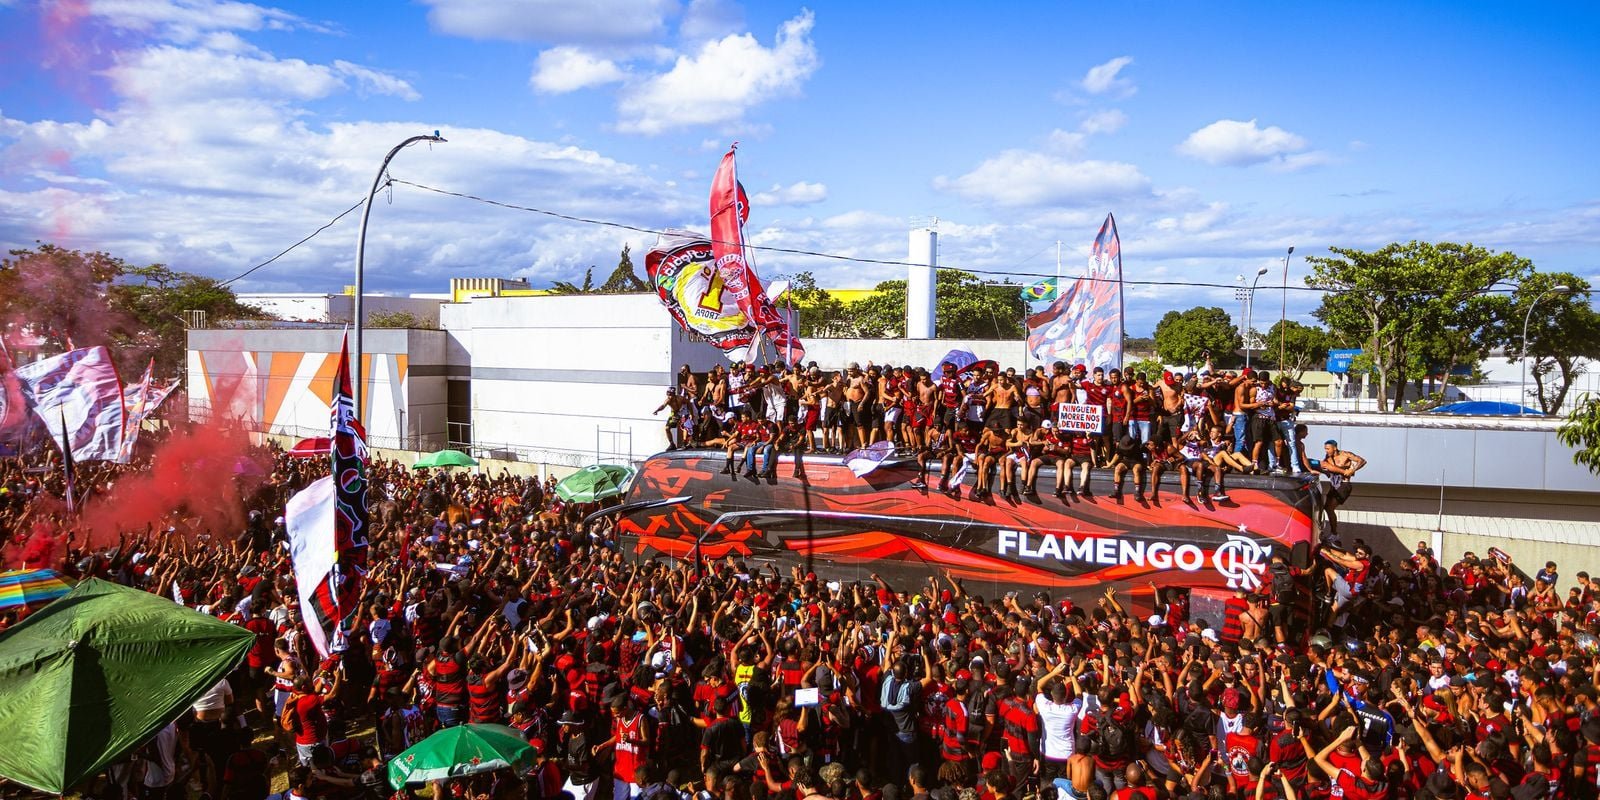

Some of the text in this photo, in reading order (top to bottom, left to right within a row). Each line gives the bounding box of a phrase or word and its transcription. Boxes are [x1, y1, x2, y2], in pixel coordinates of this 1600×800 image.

[1060, 412, 1100, 423] MORRE NOS
[1061, 420, 1099, 431] DEVENDO!
[998, 529, 1204, 571] FLAMENGO
